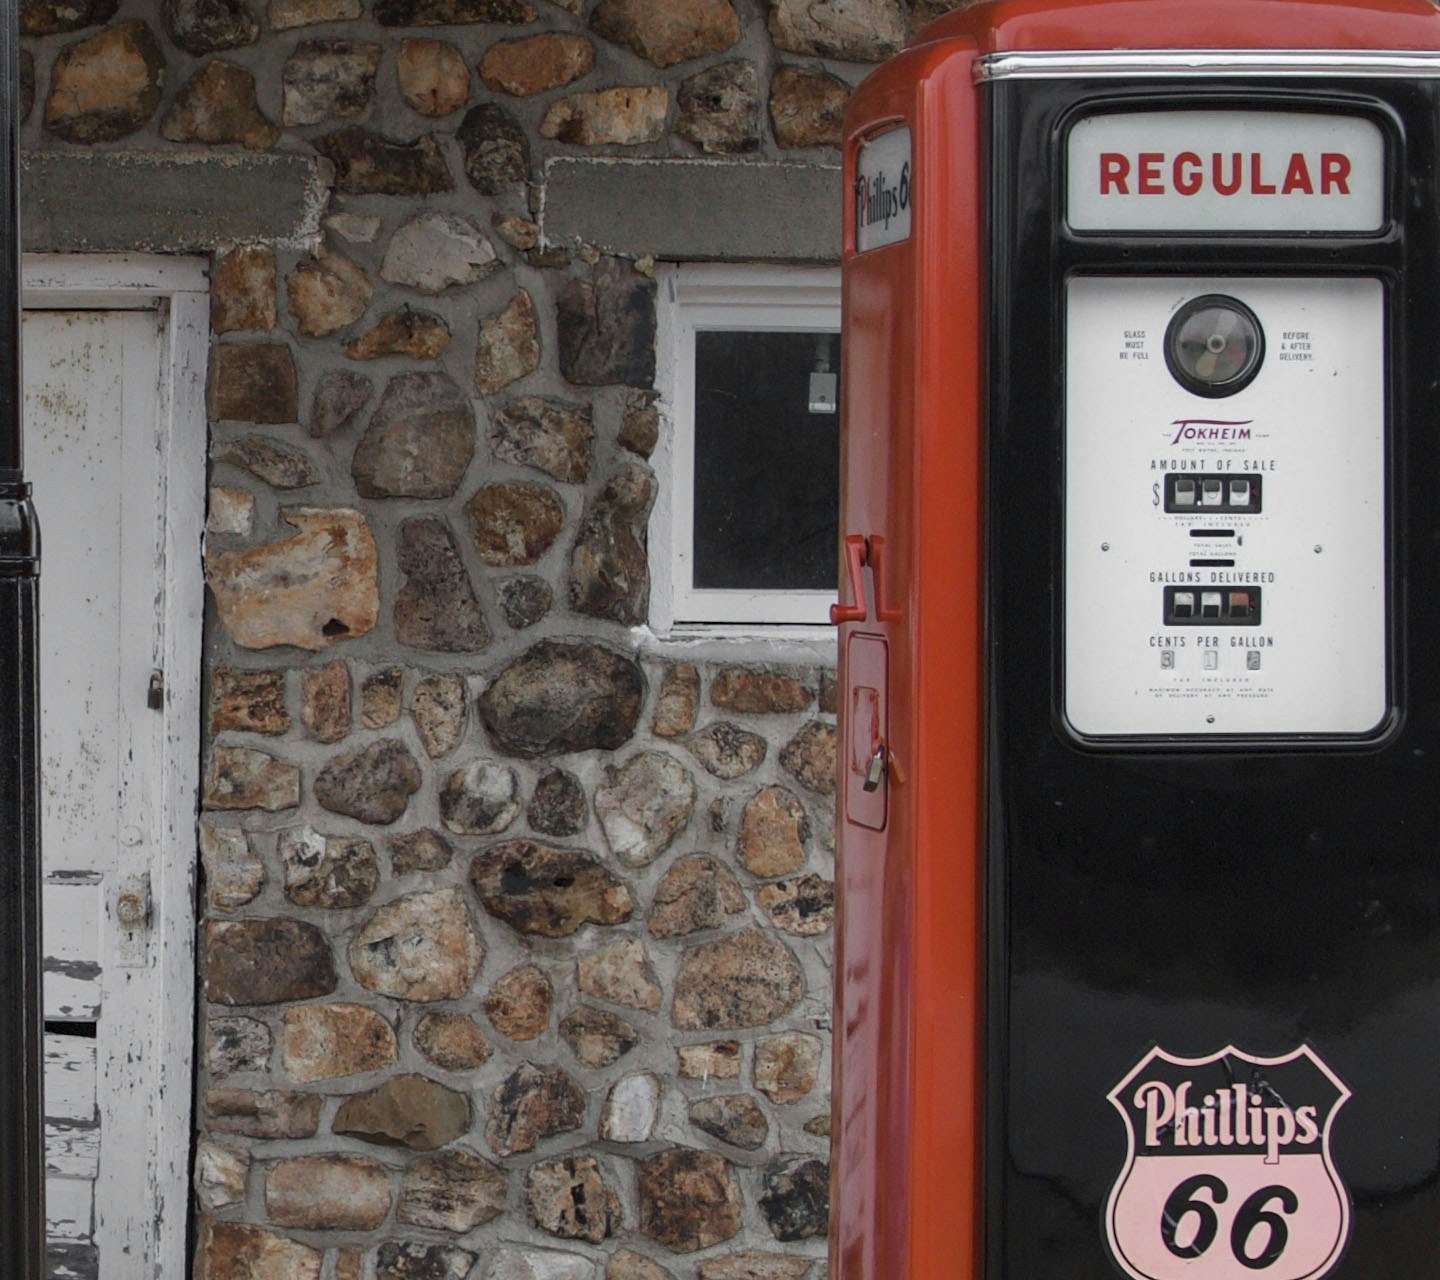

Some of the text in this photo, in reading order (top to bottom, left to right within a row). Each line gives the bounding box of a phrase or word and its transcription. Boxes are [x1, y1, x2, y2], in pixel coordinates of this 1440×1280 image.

[1100, 152, 1351, 196] REGULAR
[858, 171, 897, 230] Phillips
[1170, 419, 1254, 445] TOKHEIM
[1150, 460, 1276, 471] AMOUNT OF SALE
[1149, 572, 1275, 583] GALLONS DELIVERED
[1149, 636, 1274, 647] CENTS PER GALLON
[1133, 1080, 1319, 1164] Phillips
[1161, 1173, 1299, 1270] 66
